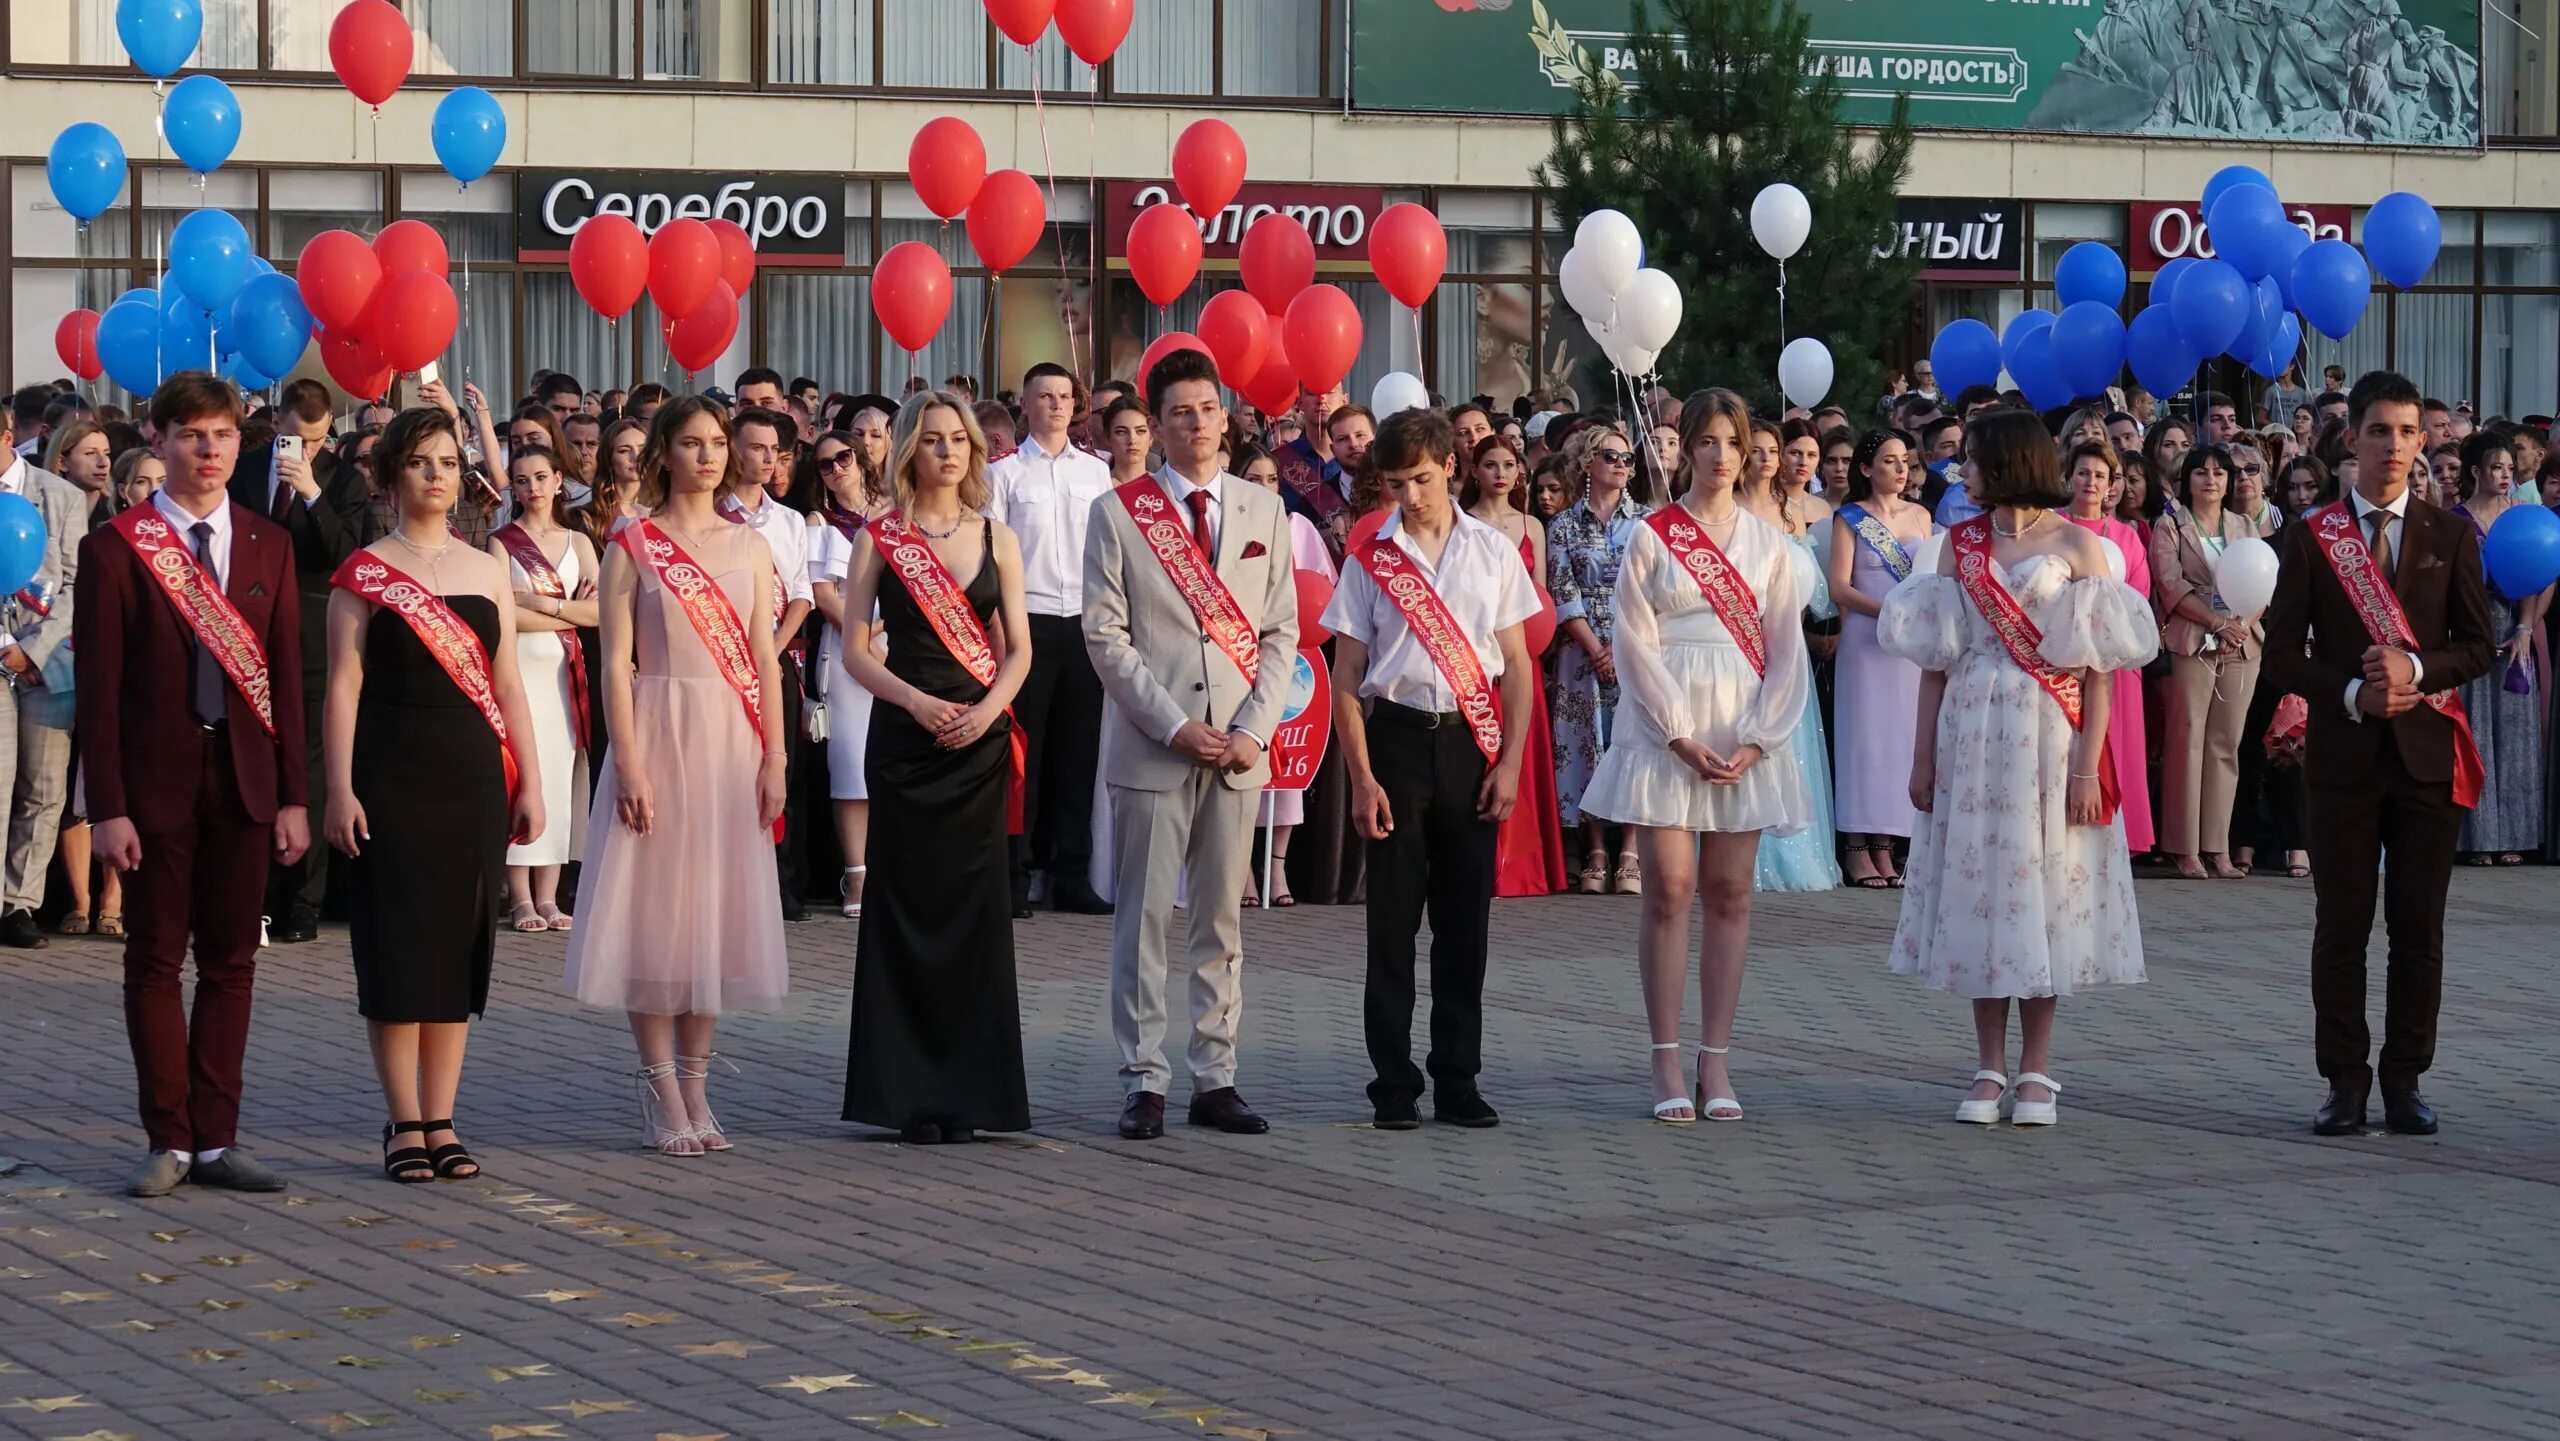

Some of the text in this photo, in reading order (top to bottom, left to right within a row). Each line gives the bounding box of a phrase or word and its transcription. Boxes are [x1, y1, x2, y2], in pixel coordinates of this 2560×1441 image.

[1882, 57, 2015, 84] ГОРДОСТЬ!
[542, 178, 827, 251] Серебро
[1229, 630, 1260, 680] 202
[1464, 693, 1503, 753] 2025
[1282, 755, 1309, 777] 16
